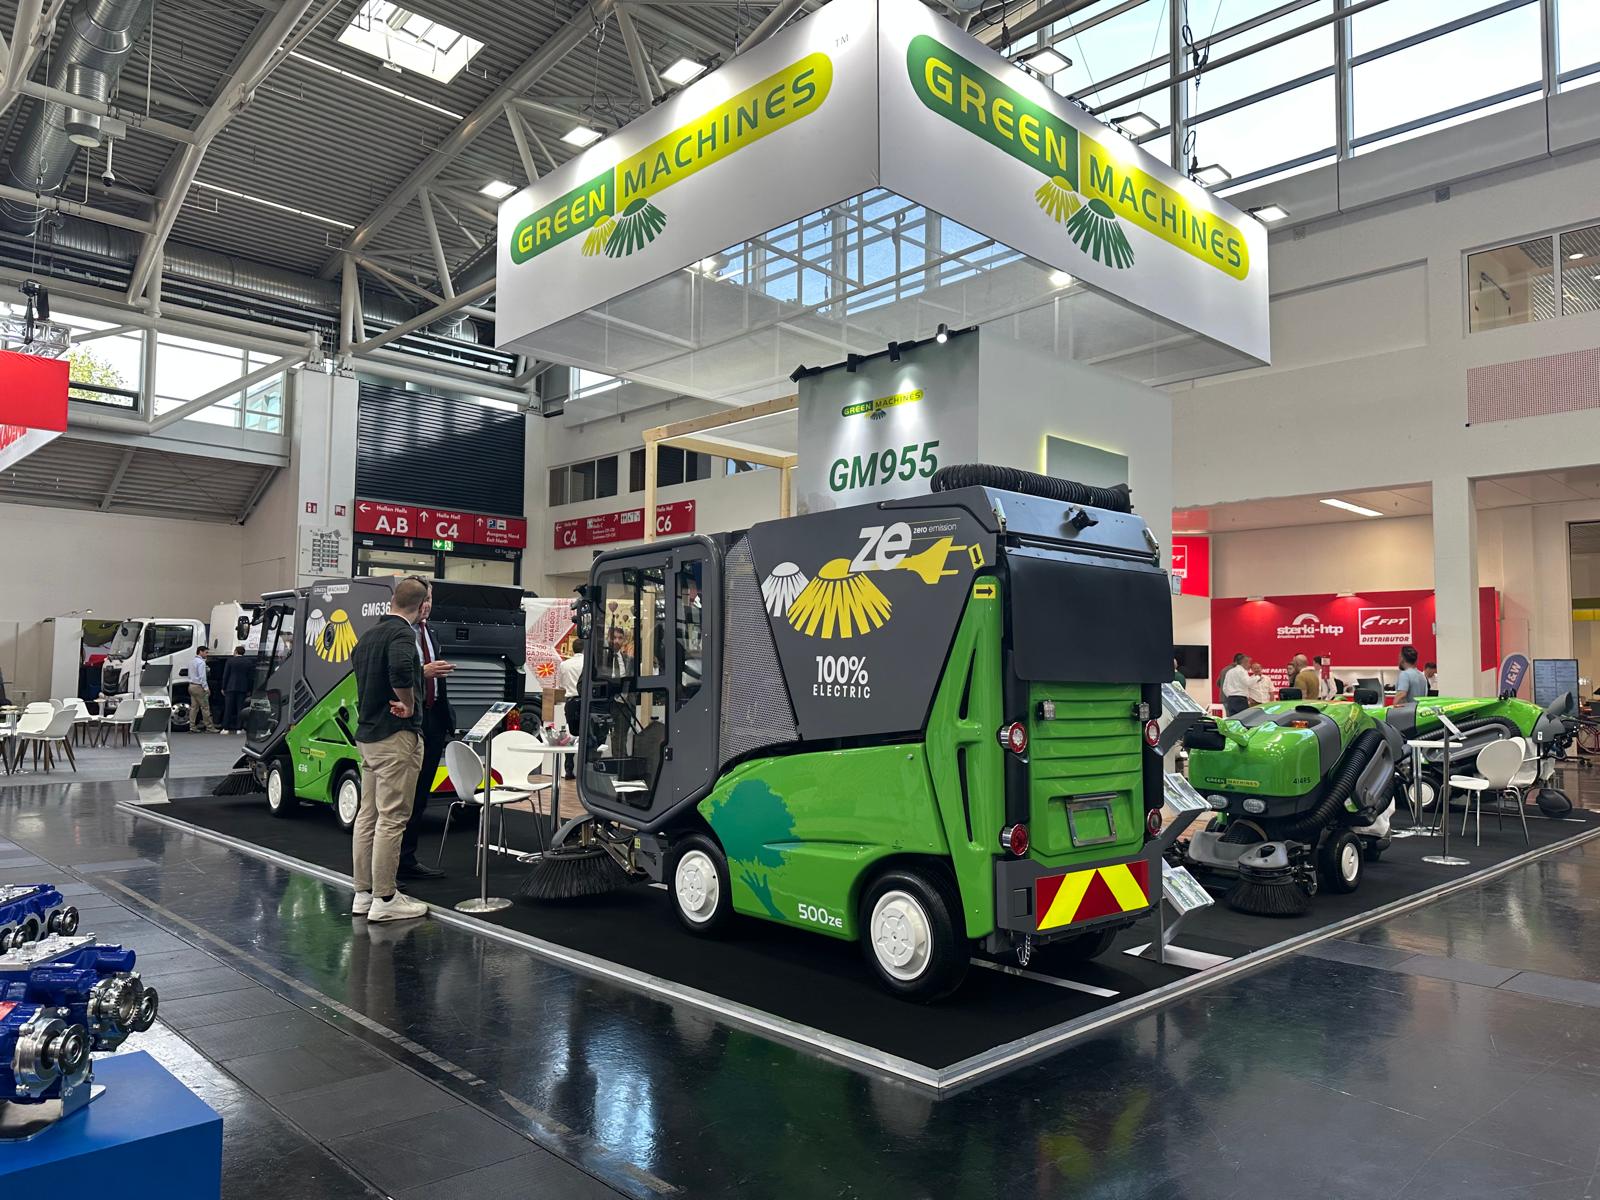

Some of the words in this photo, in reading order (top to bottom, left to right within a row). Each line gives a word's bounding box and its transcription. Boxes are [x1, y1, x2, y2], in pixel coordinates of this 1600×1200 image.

[518, 183, 606, 253] GREEN
[624, 67, 816, 198] MACHINES
[924, 56, 1067, 172] GREEN
[1089, 154, 1241, 269] MACHINES
[844, 404, 872, 416] GREEN
[875, 392, 920, 408] MACHINES
[830, 440, 939, 492] GM955
[376, 515, 408, 535] A,B
[436, 522, 458, 538] C4
[656, 515, 672, 532] C6
[564, 530, 576, 545] C4
[850, 521, 912, 572] ze
[913, 525, 927, 534] zero
[928, 522, 957, 532] emission
[362, 602, 391, 616] GM636
[1277, 624, 1343, 636] sterki-htp
[816, 656, 868, 684] 100%
[812, 684, 870, 698] ELECTRIC
[798, 903, 842, 928] 500ze
